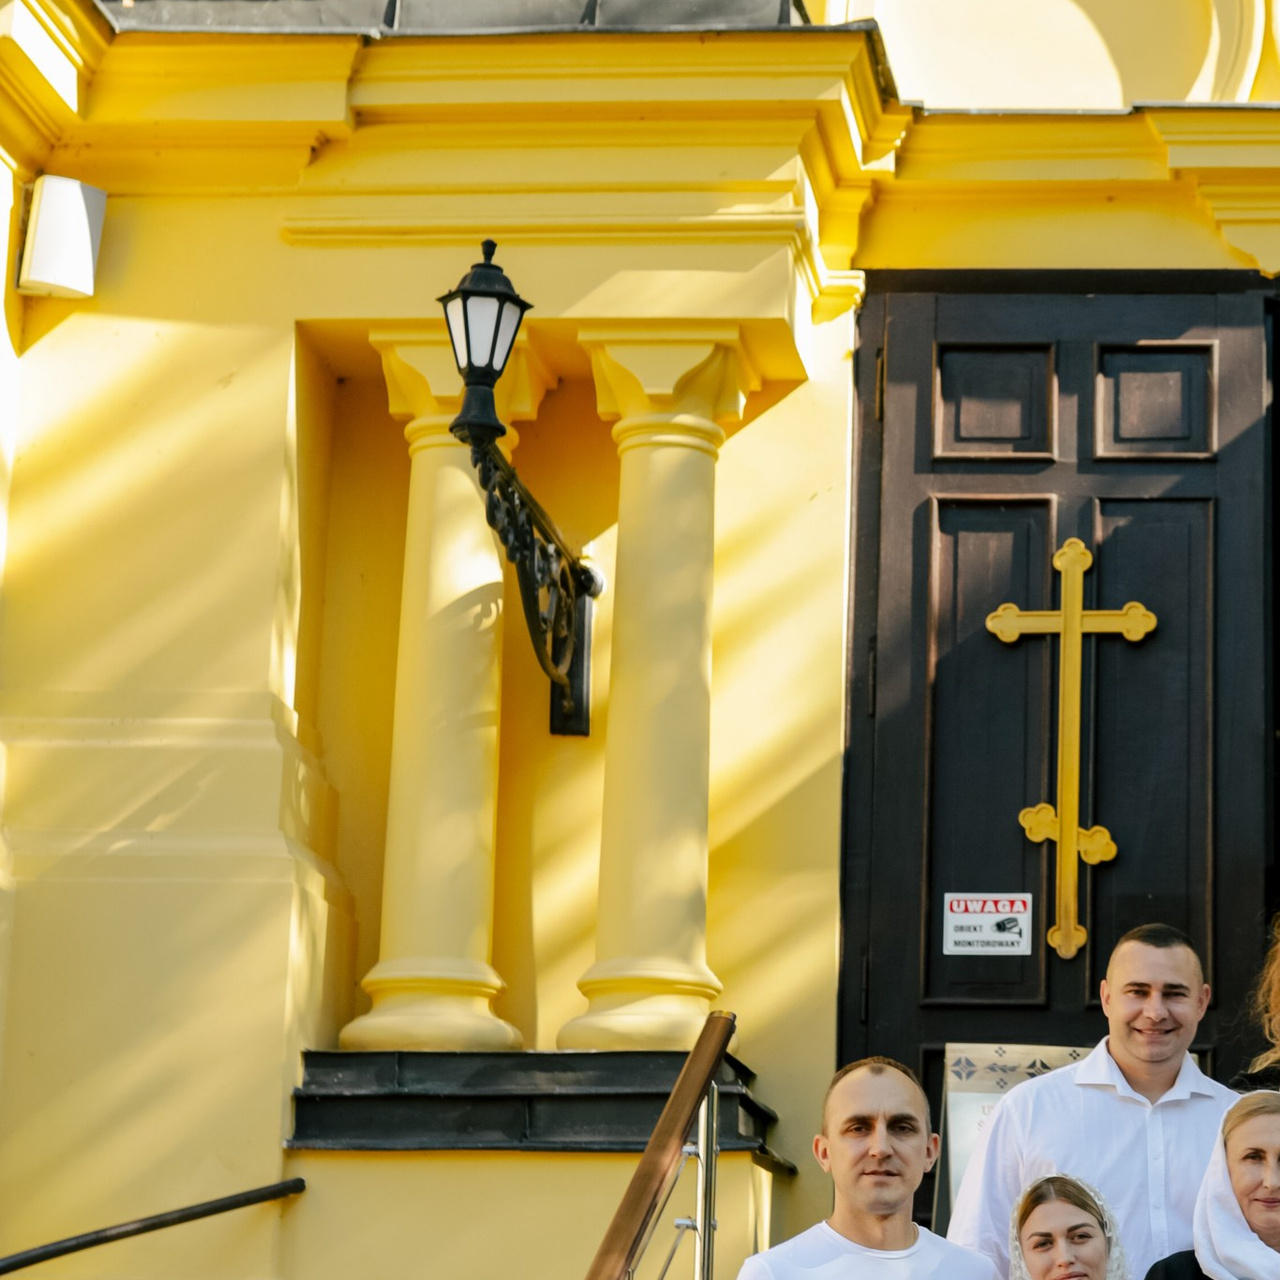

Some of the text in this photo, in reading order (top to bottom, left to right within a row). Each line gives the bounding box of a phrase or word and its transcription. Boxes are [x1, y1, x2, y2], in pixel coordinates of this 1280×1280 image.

[951, 899, 1026, 913] UWAGA
[953, 925, 983, 933] OBIEKT
[953, 940, 1021, 948] MONITOROWANY
